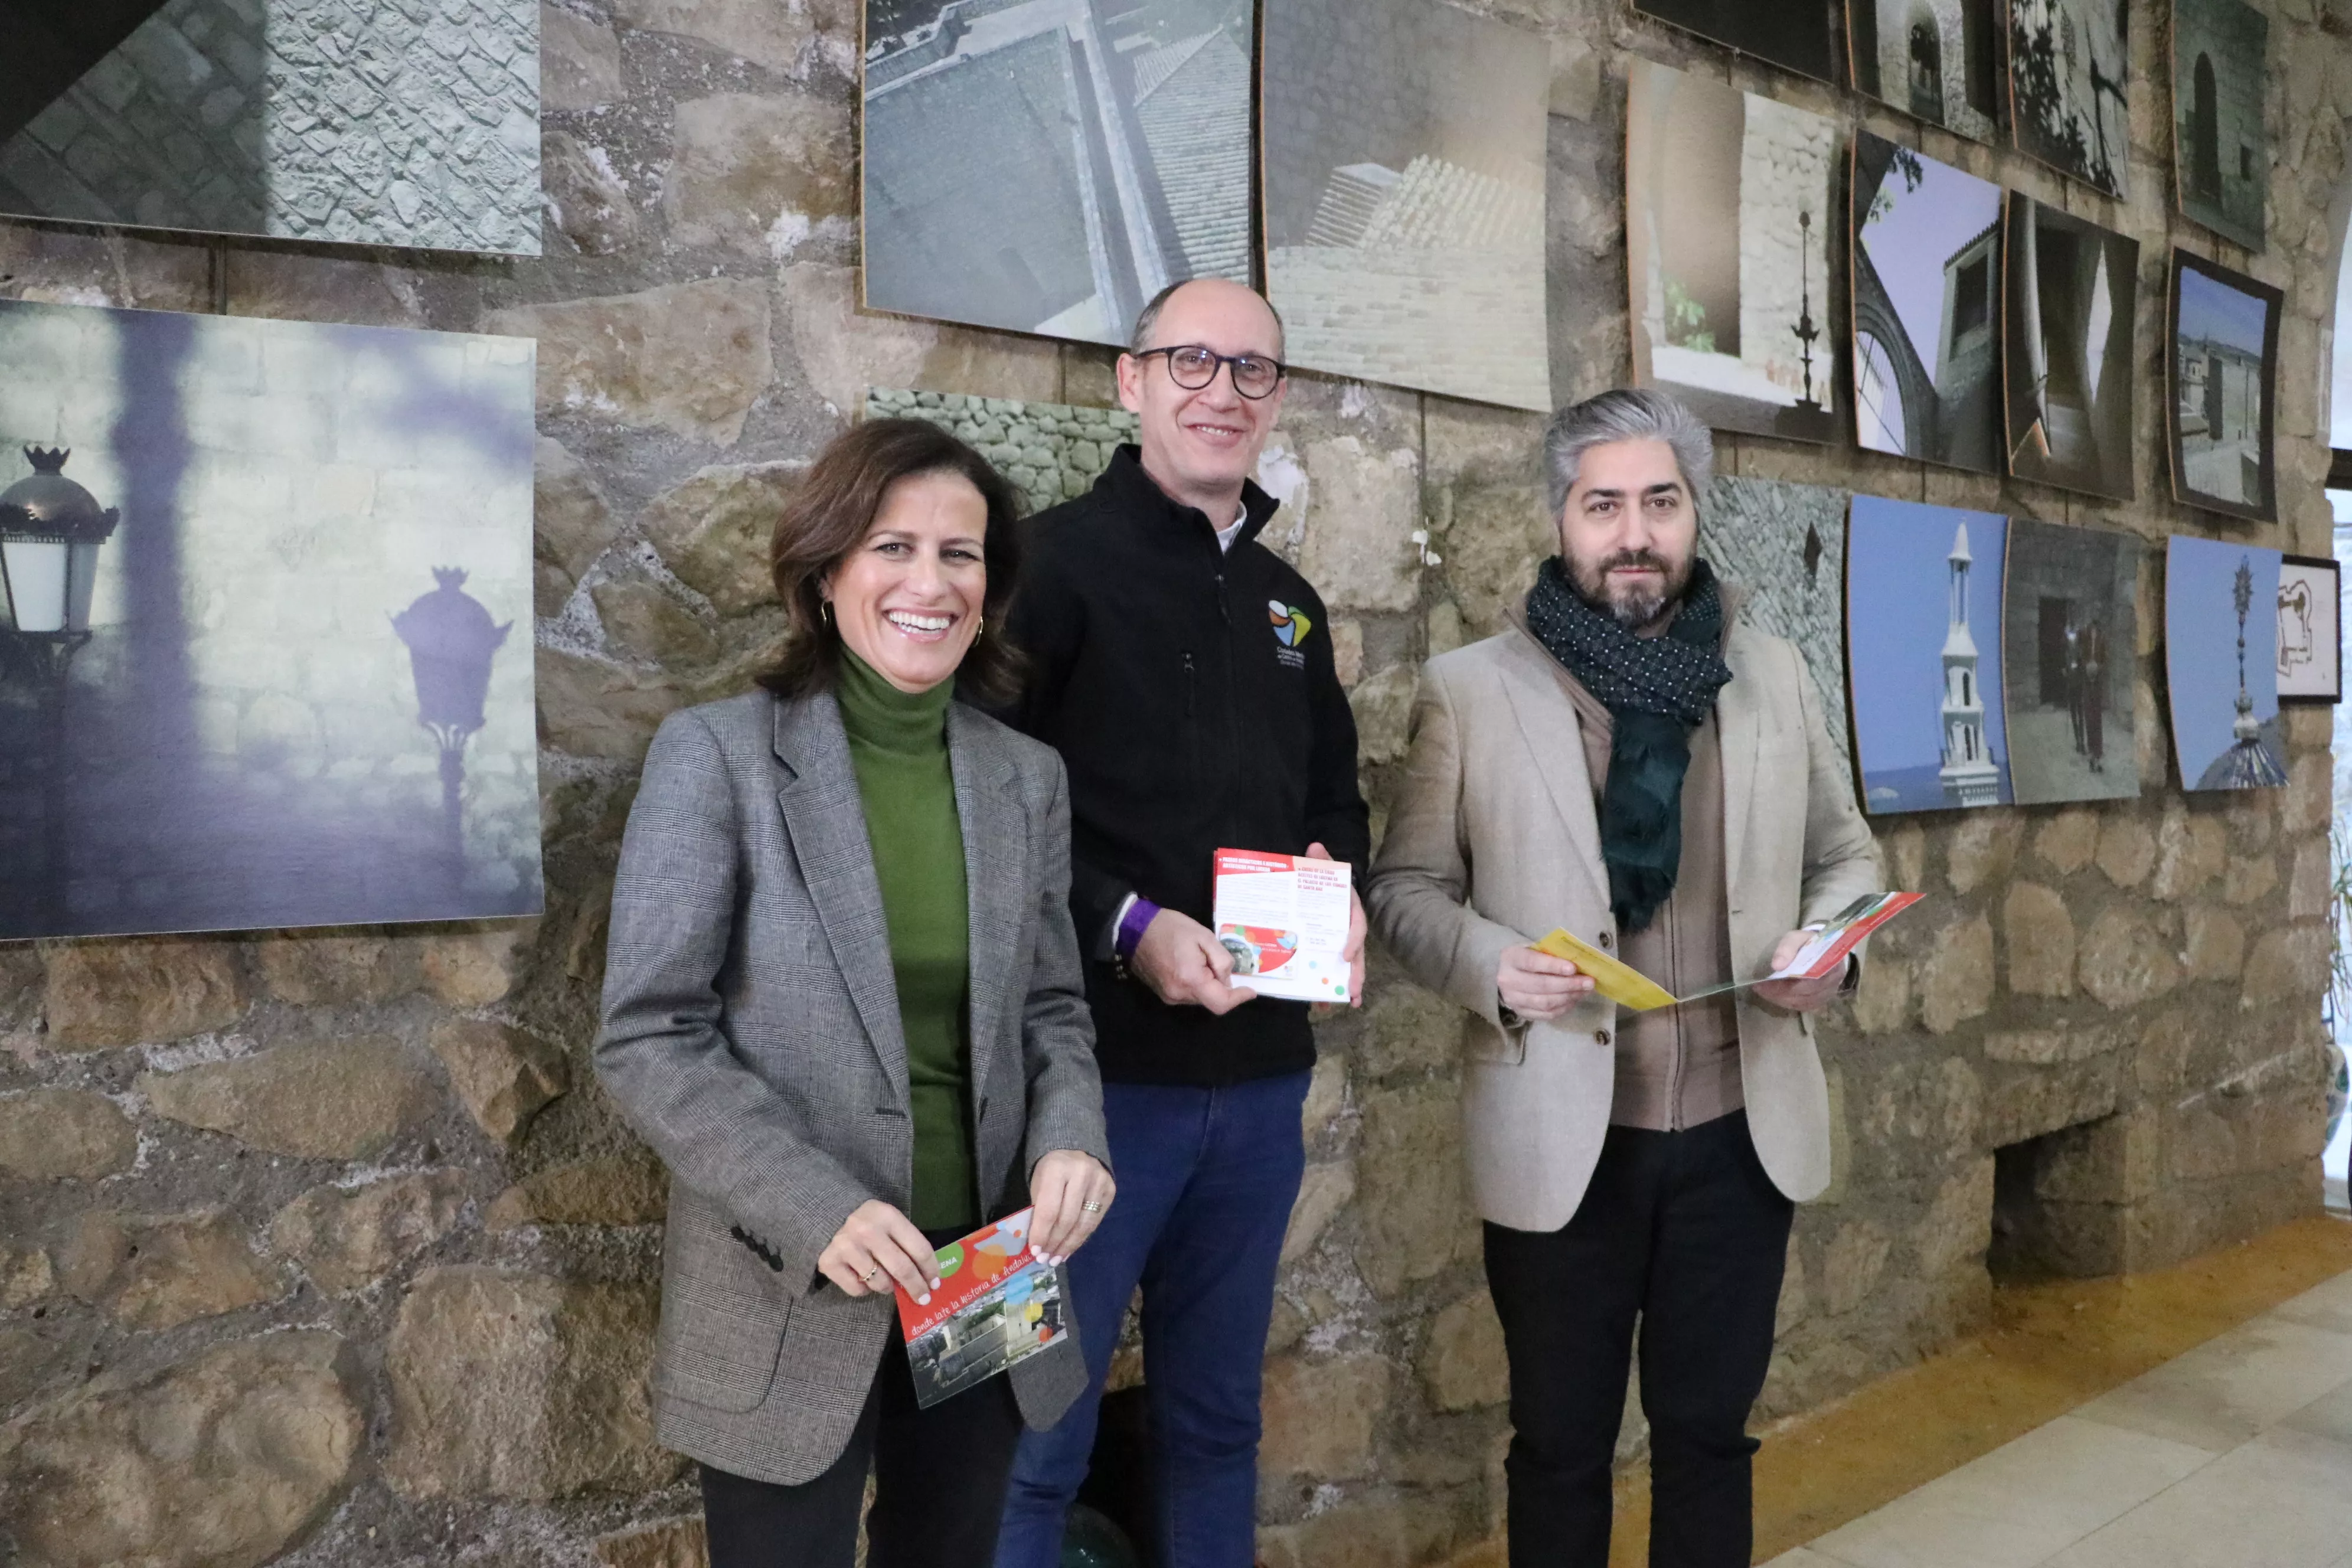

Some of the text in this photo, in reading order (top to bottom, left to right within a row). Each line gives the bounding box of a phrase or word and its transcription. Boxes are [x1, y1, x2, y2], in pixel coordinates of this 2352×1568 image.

[940, 1256, 958, 1269] ENA
[912, 1252, 1032, 1336] donde late la historia de Andaluc
